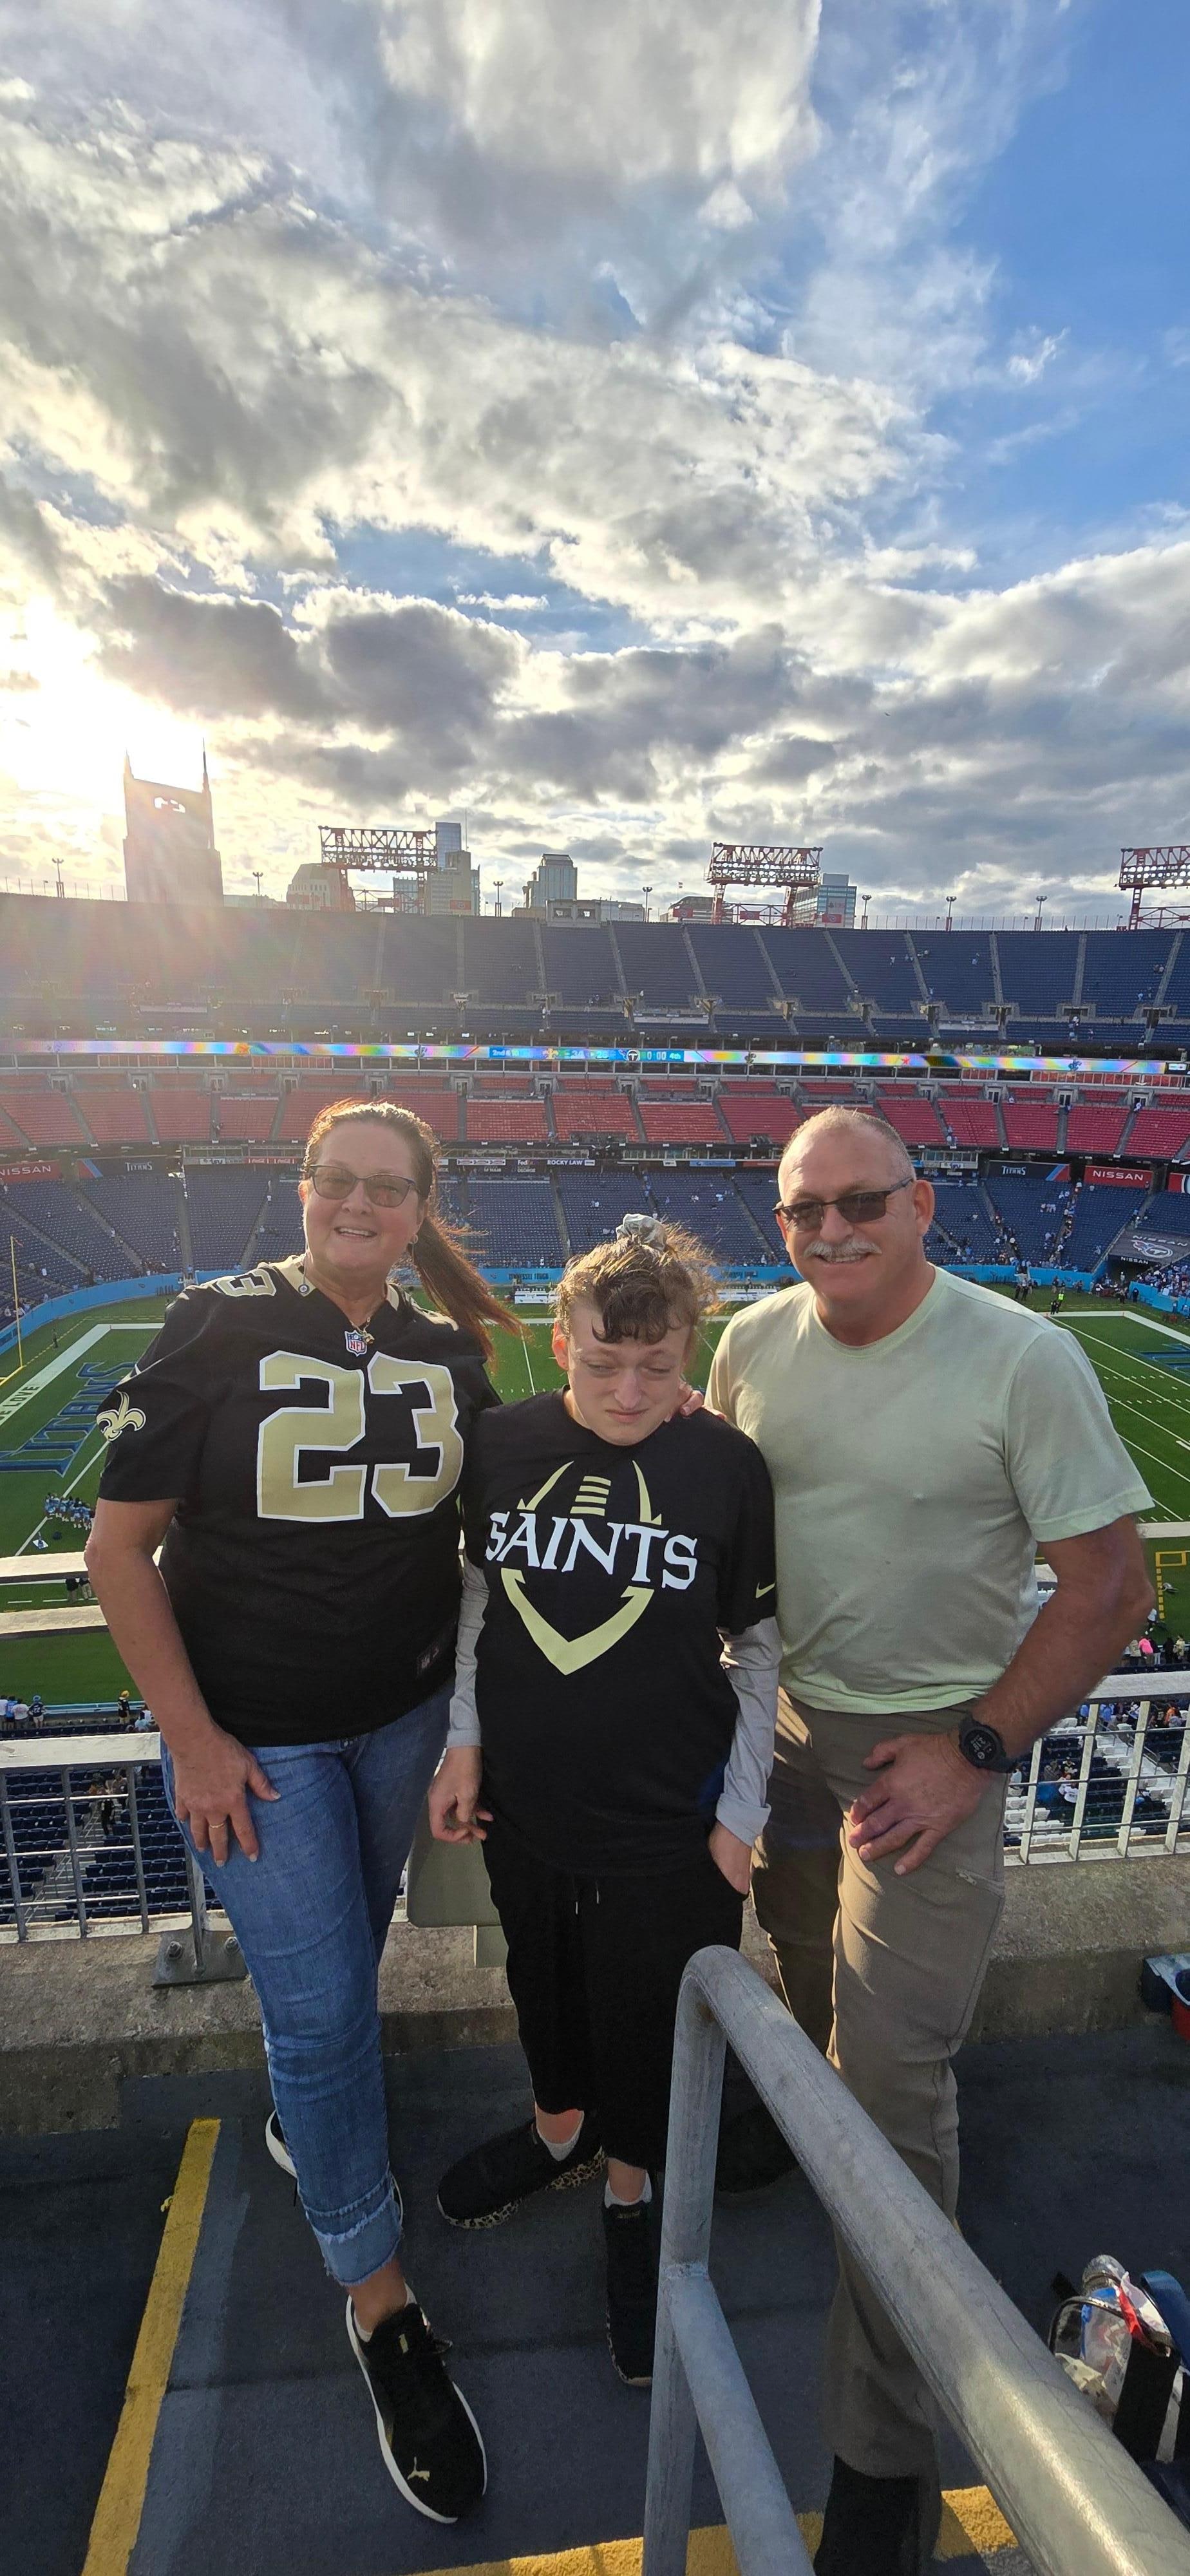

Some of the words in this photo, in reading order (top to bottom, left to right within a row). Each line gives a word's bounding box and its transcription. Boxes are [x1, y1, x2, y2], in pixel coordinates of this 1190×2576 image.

[125, 1161, 153, 1171] TITANS
[1002, 1166, 1026, 1175] TITANS
[1093, 1170, 1144, 1180] NISSAN
[1133, 1235, 1187, 1246] NISSAN
[349, 1340, 365, 1352] NFL
[3, 1386, 41, 1406] LOVE
[258, 1350, 464, 1522] 23
[485, 1511, 698, 1590] SAINTS
